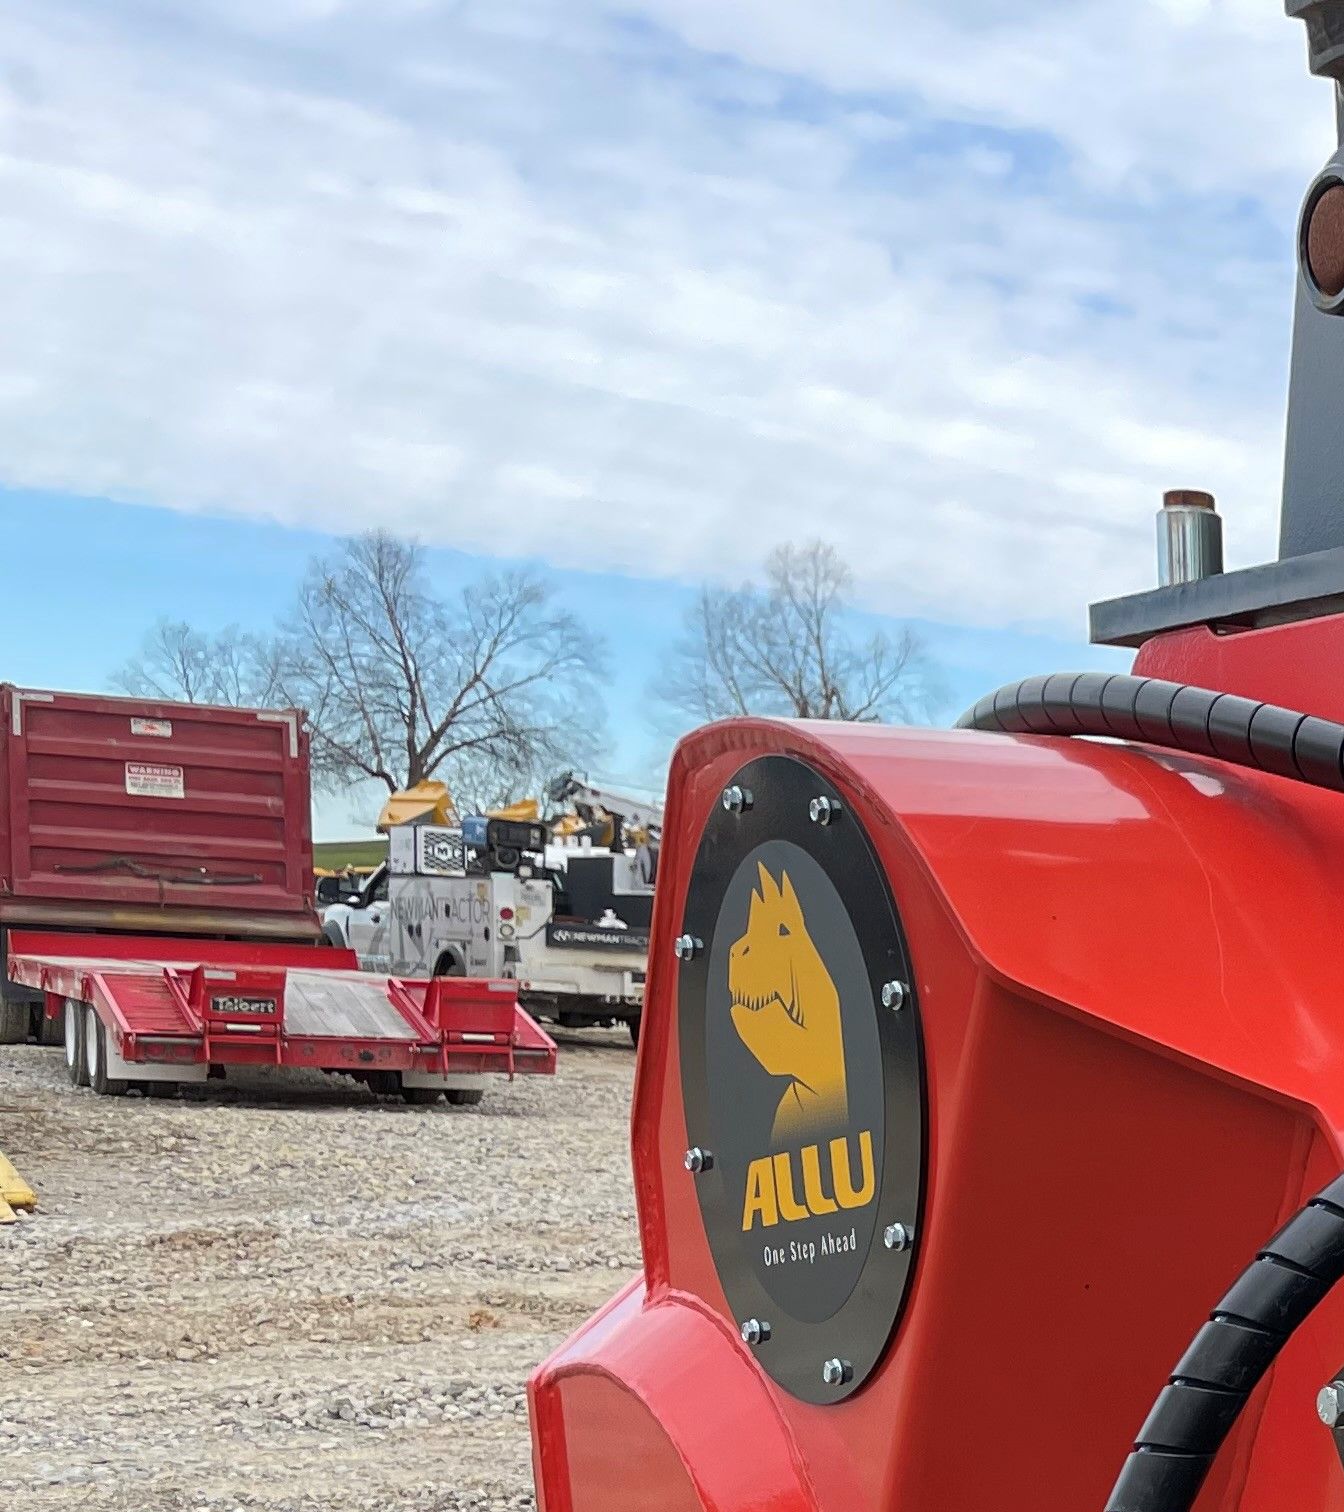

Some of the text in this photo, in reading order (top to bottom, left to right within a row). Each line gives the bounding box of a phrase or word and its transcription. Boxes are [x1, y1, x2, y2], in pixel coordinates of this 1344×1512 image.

[129, 765, 180, 777] WARNING
[388, 896, 491, 924] NEWMANTACTOR
[742, 1130, 875, 1231] ALLU
[763, 1228, 856, 1267] One Step Ahead
